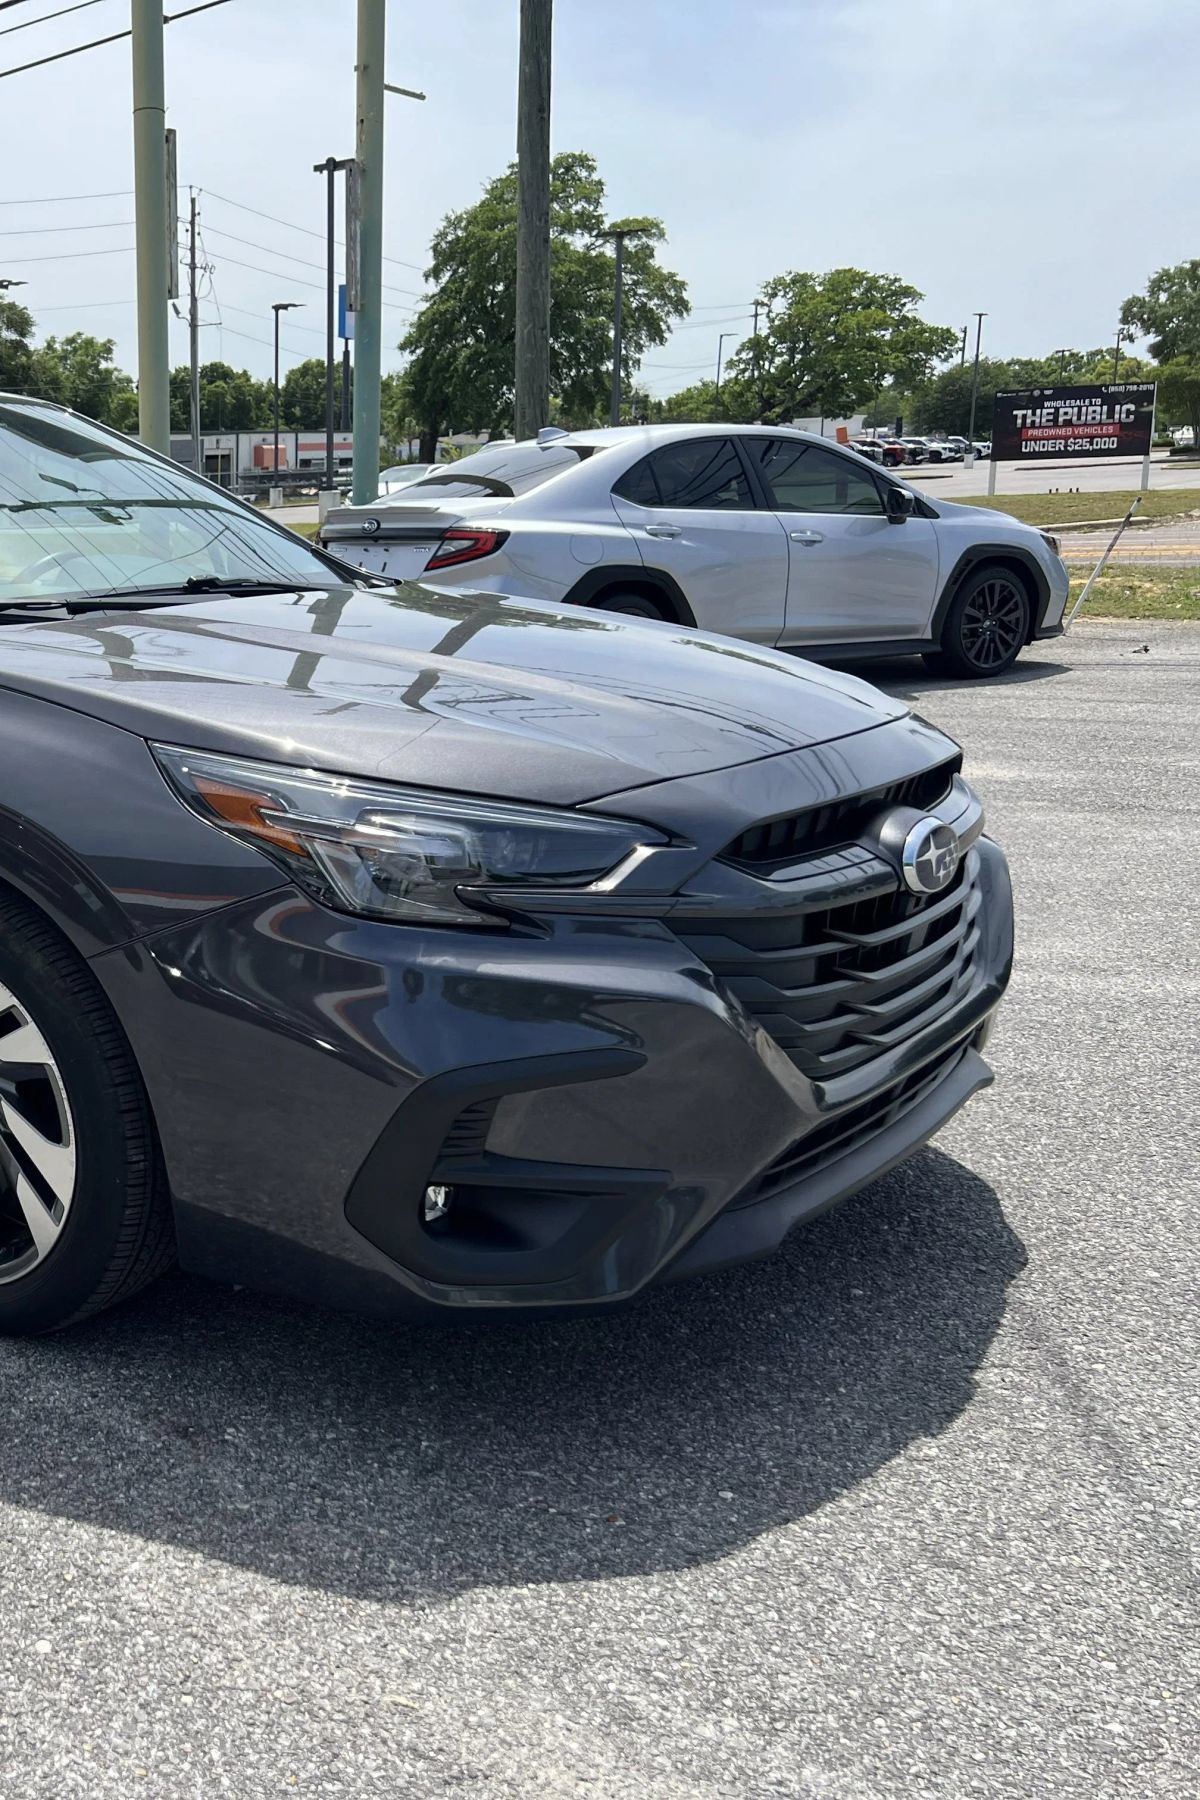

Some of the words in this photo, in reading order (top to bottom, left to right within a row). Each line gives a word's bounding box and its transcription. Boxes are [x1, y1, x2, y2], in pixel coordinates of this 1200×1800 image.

[1044, 399, 1090, 408] WHOLESALE
[1091, 398, 1102, 406] TO
[1013, 407, 1054, 428] THE
[1058, 403, 1136, 426] PUBLIC
[1027, 427, 1072, 437] PREOWNED
[1074, 425, 1114, 435] VEHICLES
[1021, 439, 1065, 453] UNDER
[1067, 437, 1118, 452] $25,000
